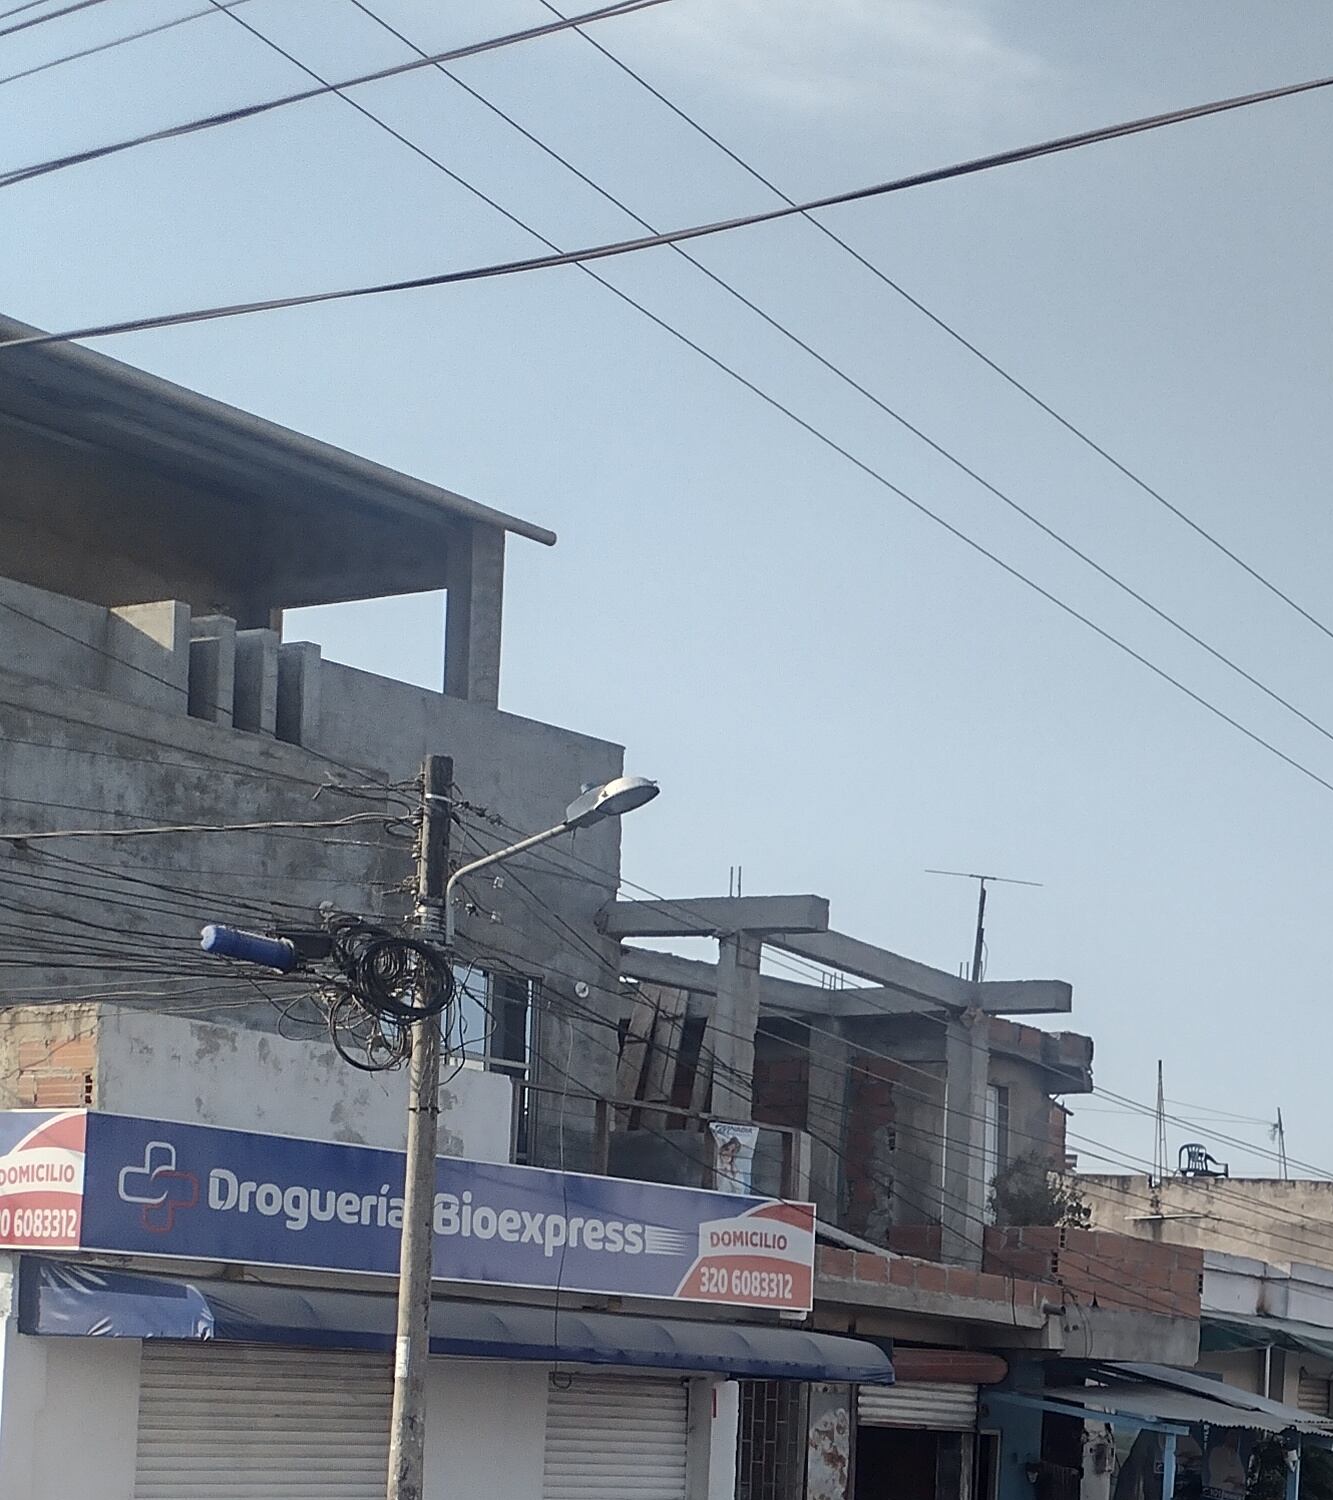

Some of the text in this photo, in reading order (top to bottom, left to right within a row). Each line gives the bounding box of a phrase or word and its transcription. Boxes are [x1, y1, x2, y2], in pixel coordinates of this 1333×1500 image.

[208, 1168, 404, 1231] Droguería
[14, 1208, 77, 1238] 6083312
[433, 1190, 643, 1257] Bioexpress
[710, 1231, 788, 1250] DOMICILIO
[700, 1266, 793, 1299] 320 6083312
